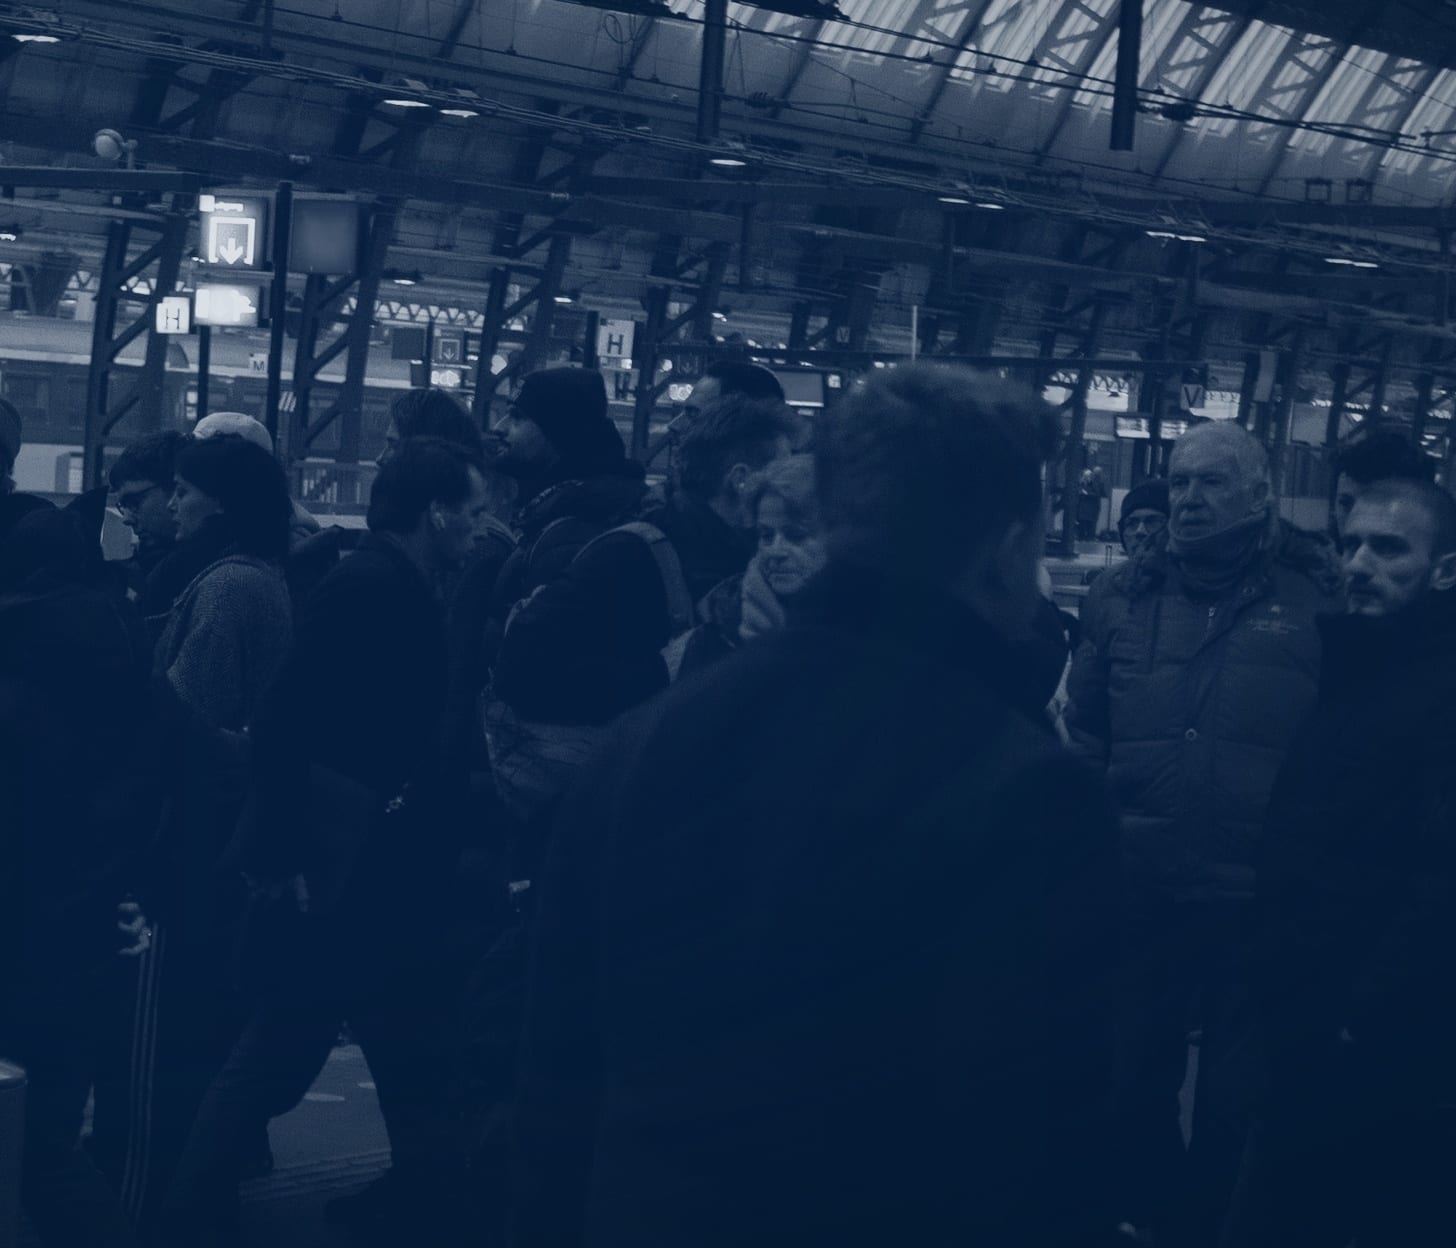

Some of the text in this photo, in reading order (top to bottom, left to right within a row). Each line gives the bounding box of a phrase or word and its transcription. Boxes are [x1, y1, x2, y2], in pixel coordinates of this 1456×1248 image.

[165, 308, 180, 331] H
[607, 334, 624, 355] H
[253, 360, 265, 371] M
[1183, 386, 1201, 408] V
